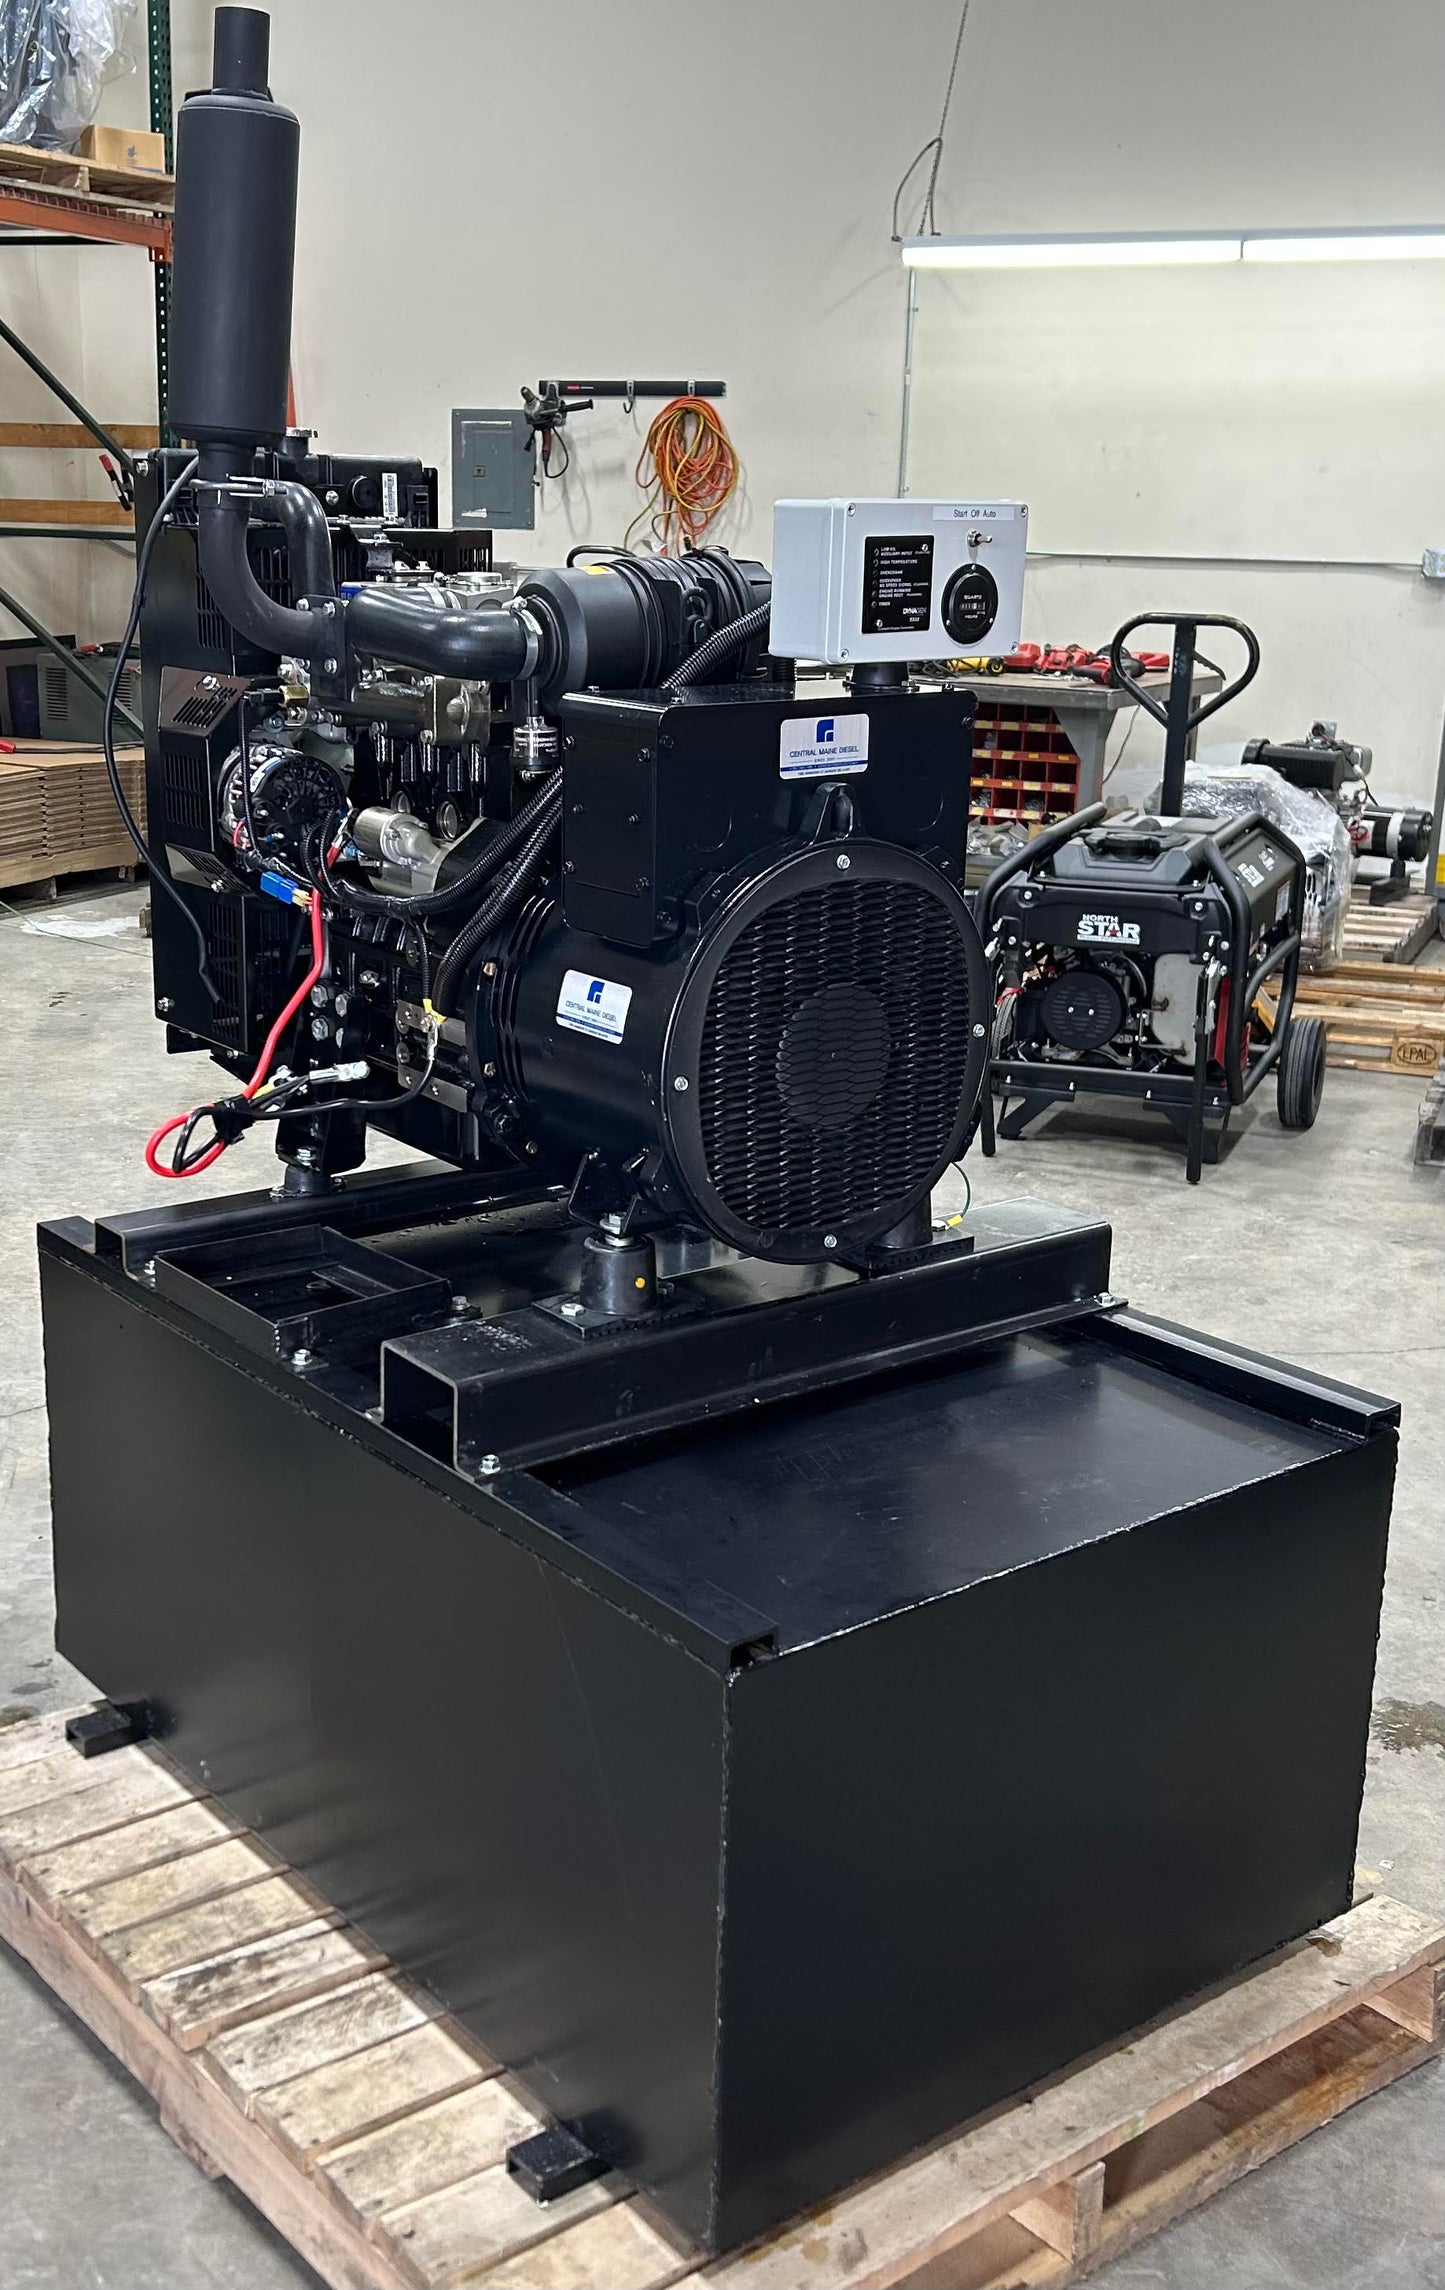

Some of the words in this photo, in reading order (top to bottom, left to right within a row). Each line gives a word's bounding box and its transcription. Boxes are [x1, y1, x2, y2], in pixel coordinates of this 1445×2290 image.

[953, 509, 968, 518] Start
[970, 509, 980, 518] Off
[982, 508, 996, 518] Auto
[790, 749, 817, 758] CENTRAL
[1082, 913, 1119, 923] NORTH
[1077, 920, 1141, 939] STAR
